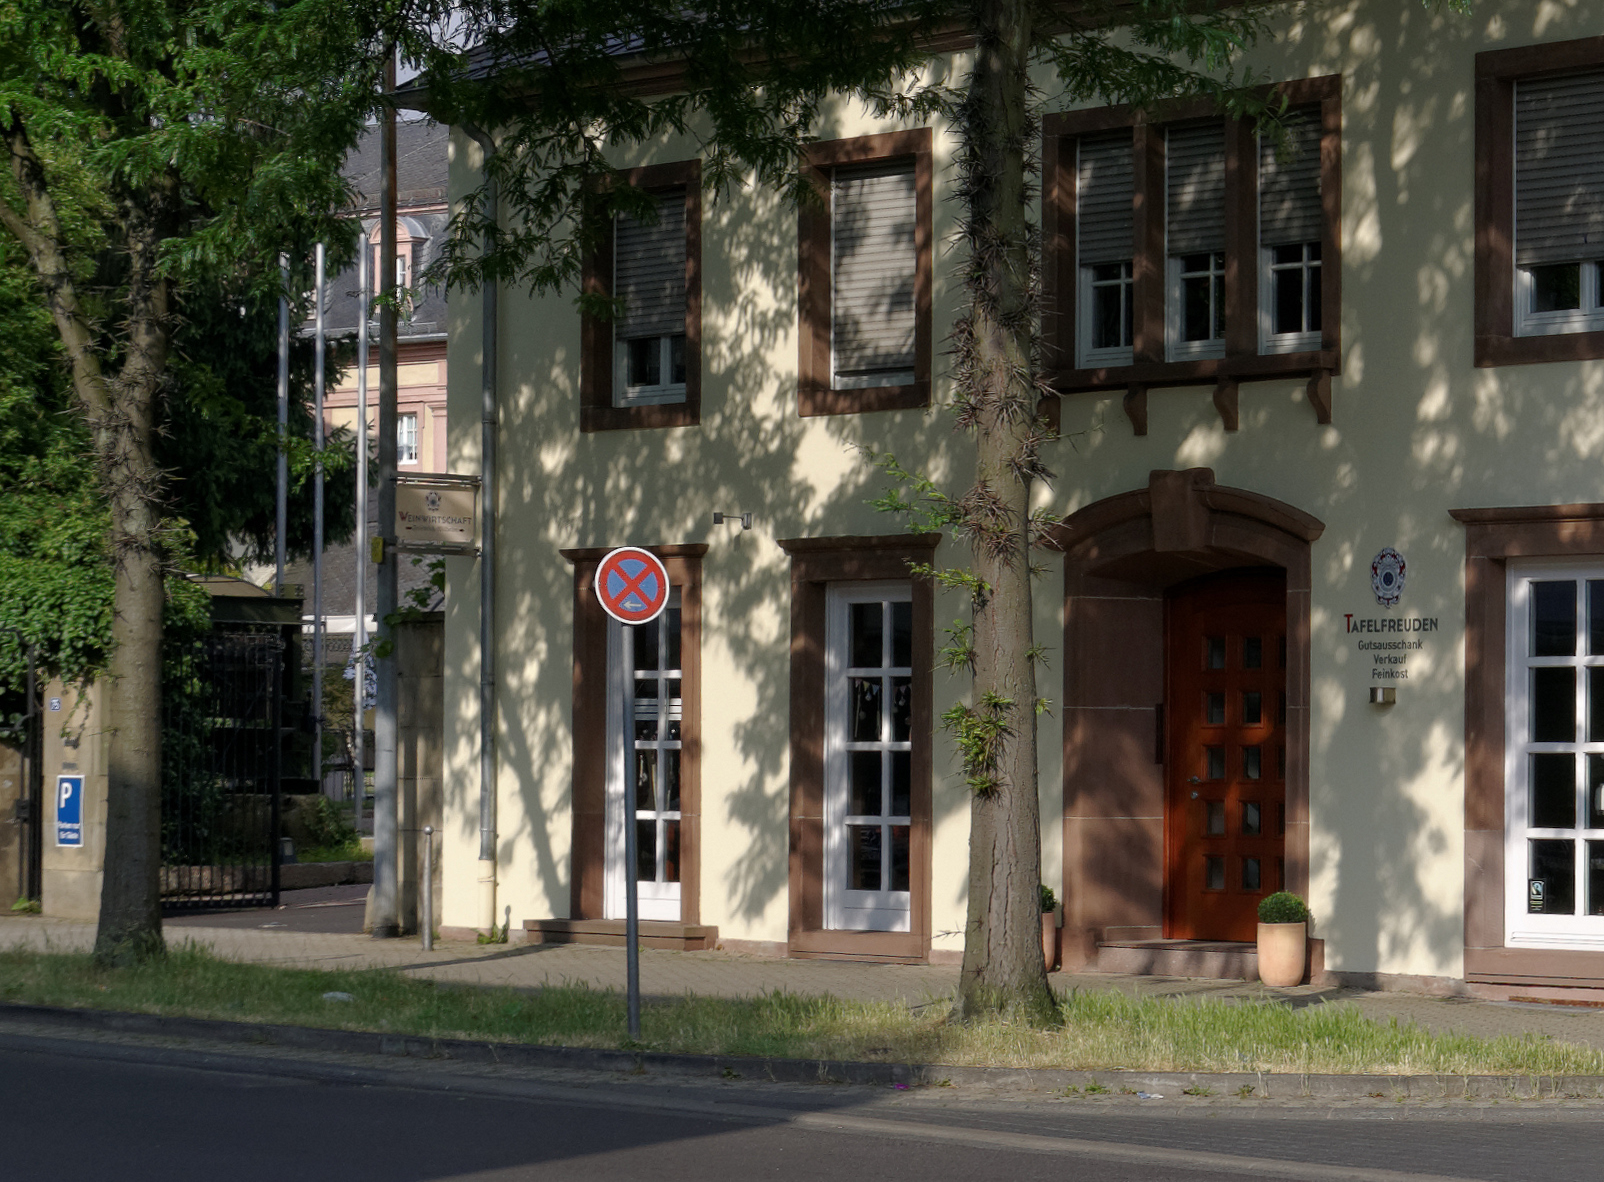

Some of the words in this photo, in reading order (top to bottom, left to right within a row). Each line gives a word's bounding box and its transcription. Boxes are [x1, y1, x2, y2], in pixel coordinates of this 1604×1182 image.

[1344, 614, 1438, 633] TAFELFREUDEN
[1358, 639, 1423, 650] Gutsausschank
[1373, 654, 1407, 664] Verkauf
[1372, 668, 1408, 679] Feinkost
[60, 782, 73, 809] P
